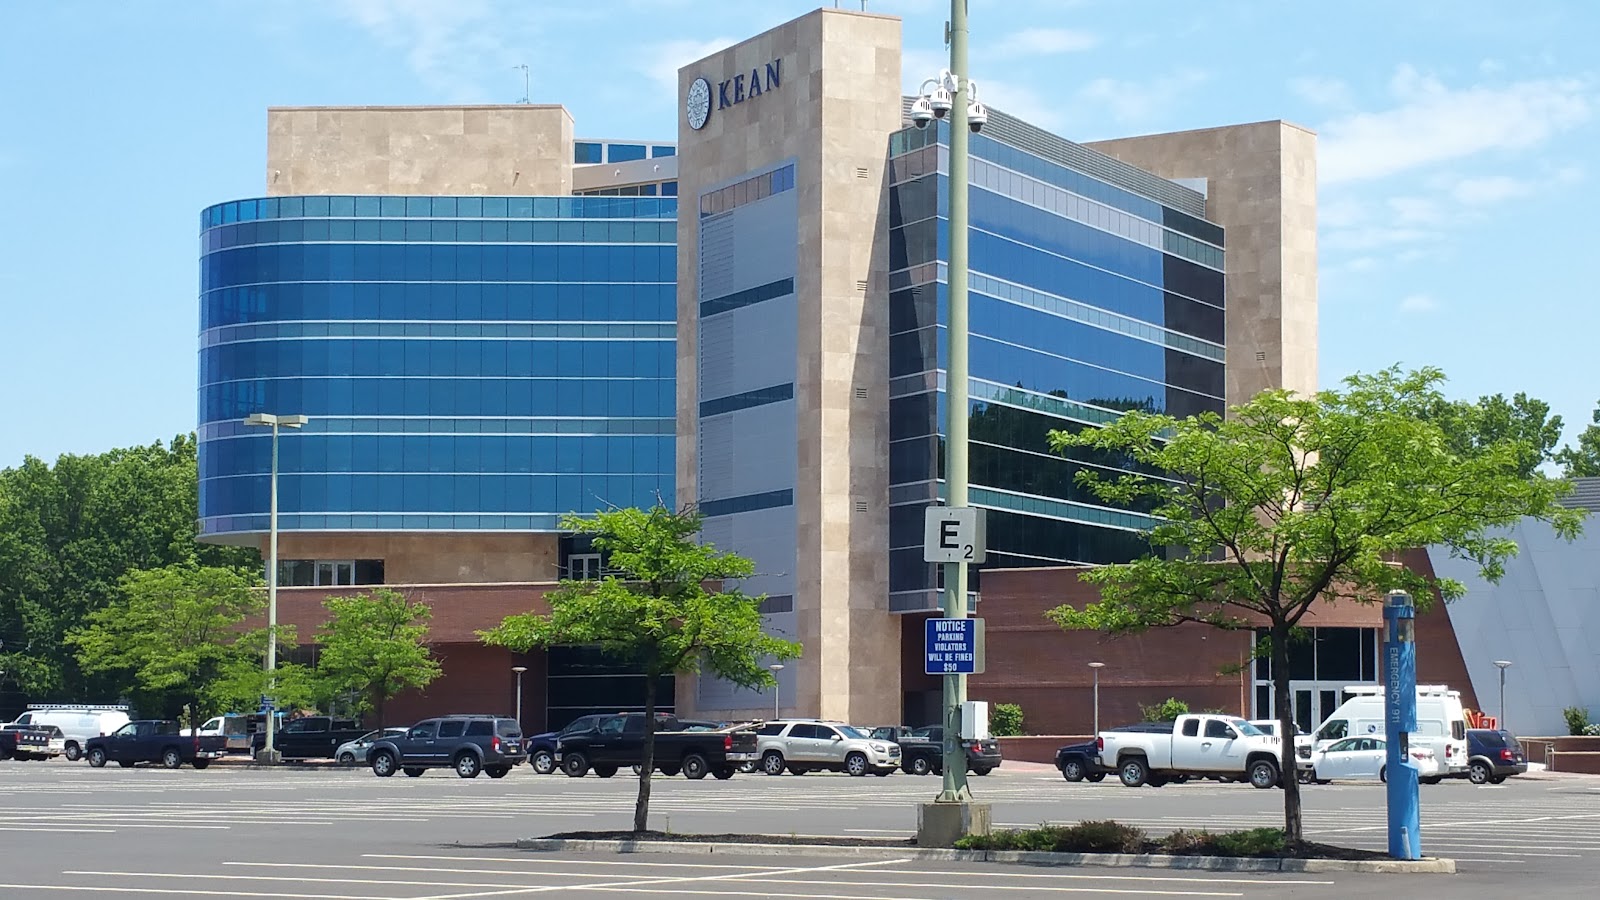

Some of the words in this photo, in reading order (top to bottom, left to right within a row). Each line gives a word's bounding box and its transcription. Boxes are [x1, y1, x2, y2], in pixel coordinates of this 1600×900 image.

[718, 59, 781, 111] KEAN
[939, 520, 961, 549] E
[963, 544, 974, 559] 2
[935, 620, 966, 632] NOTICE
[937, 632, 964, 641] PARKING
[934, 642, 967, 651] VIOLATORS
[928, 653, 943, 662] WILL
[944, 653, 953, 662] BE
[955, 653, 973, 662] FINED
[943, 662, 958, 672] $50
[1390, 647, 1400, 706] EMERGENCY
[1391, 709, 1401, 723] 911
